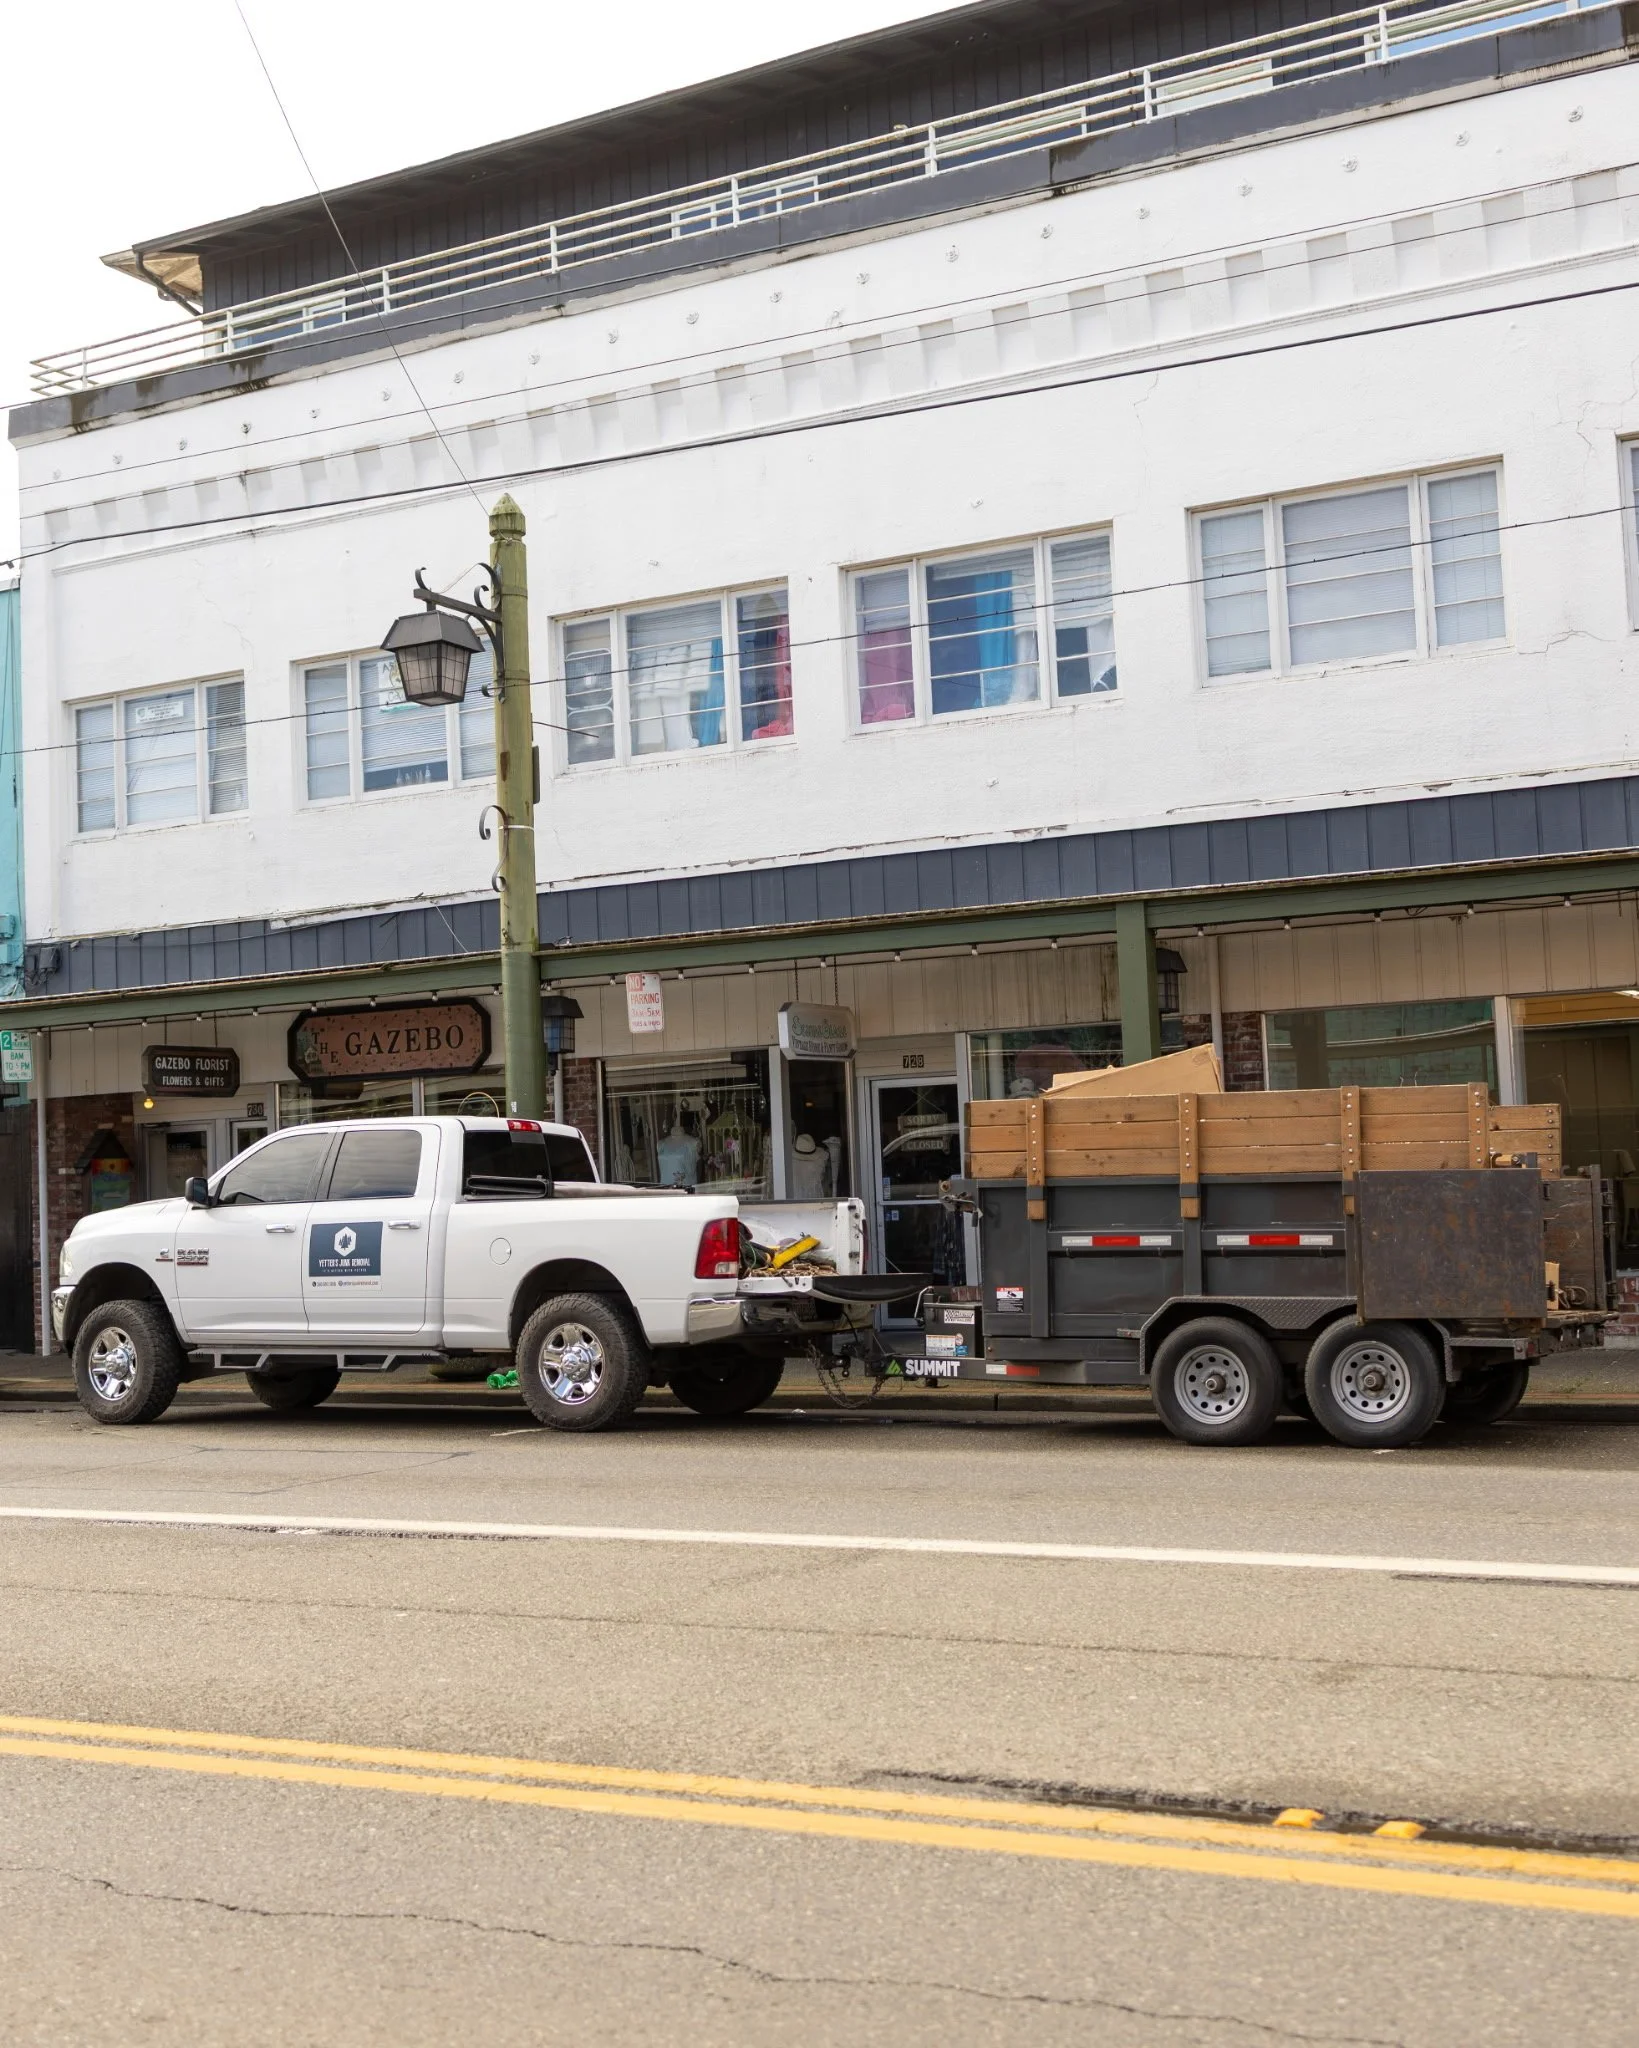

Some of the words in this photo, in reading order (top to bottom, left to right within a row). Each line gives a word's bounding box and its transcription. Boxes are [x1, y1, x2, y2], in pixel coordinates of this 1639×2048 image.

[629, 975, 641, 990] NO
[631, 993, 660, 1004] PARKING
[3, 1034, 10, 1047] 2
[311, 1032, 339, 1063] THE
[345, 1024, 464, 1056] GAZEBO
[5, 1062, 13, 1070] TO
[20, 1061, 30, 1070] PM
[155, 1057, 190, 1069] GAZEBO
[195, 1058, 229, 1070] FLORIST
[903, 1055, 924, 1068] 728
[162, 1076, 192, 1086] FLOWERS
[195, 1077, 201, 1086] &
[204, 1076, 225, 1086] GIFTS
[907, 1115, 940, 1125] SORRY
[907, 1141, 943, 1150] CLOSED
[339, 1259, 350, 1267] JUNK
[905, 1359, 960, 1377] SUMMIT
